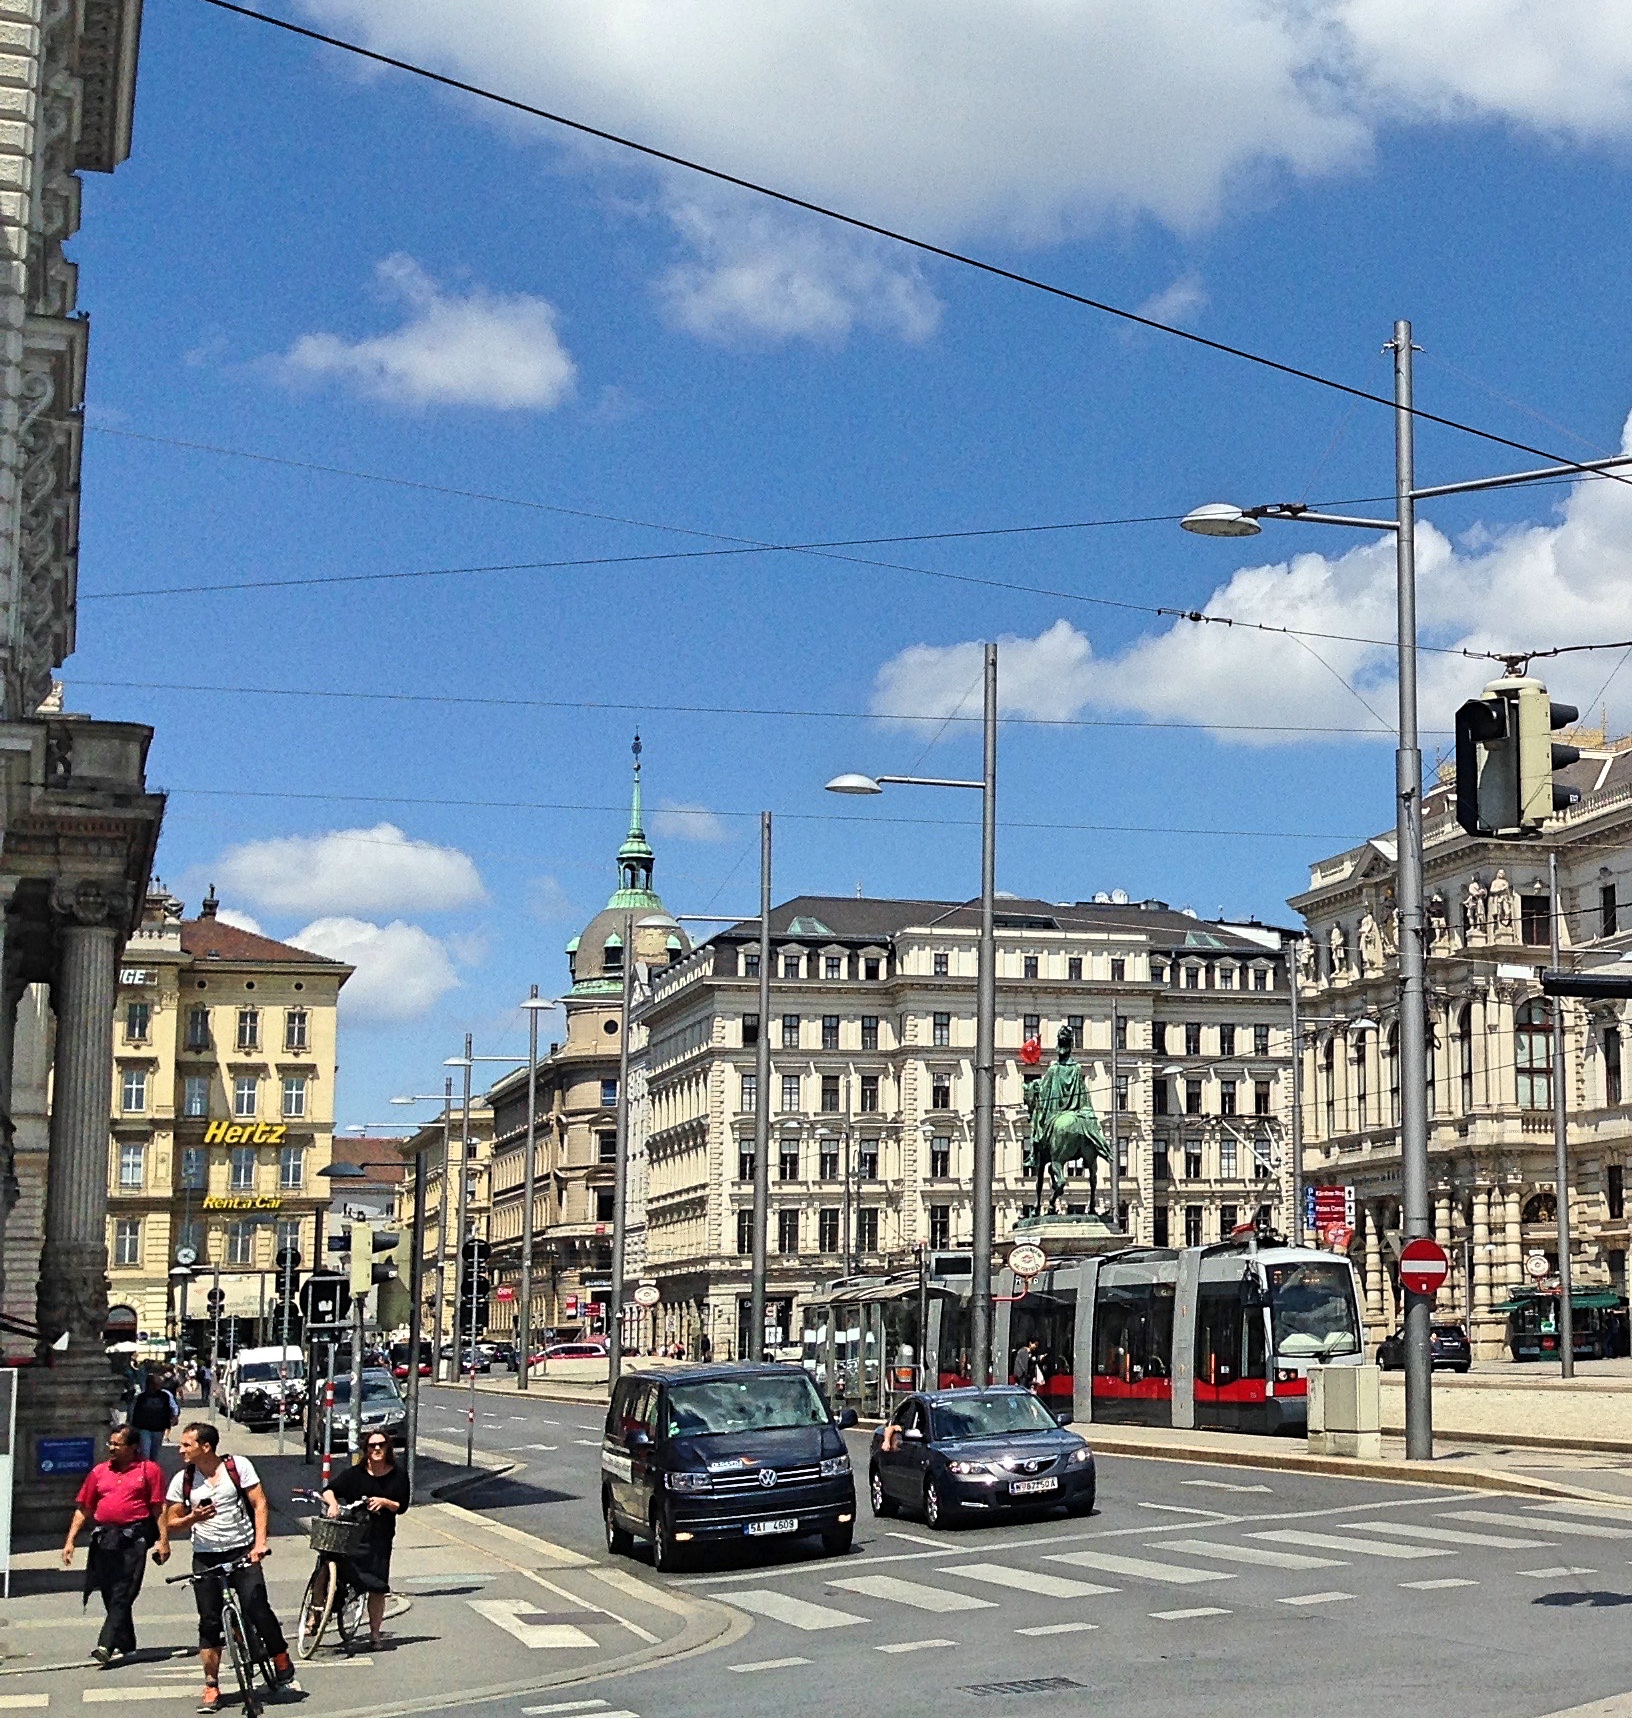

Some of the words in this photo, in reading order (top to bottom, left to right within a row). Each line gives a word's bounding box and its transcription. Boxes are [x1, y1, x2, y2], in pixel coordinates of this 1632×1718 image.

[204, 1121, 287, 1144] Hertz
[202, 1195, 242, 1209] Rent
[242, 1200, 252, 1209] a
[255, 1194, 282, 1209] Car
